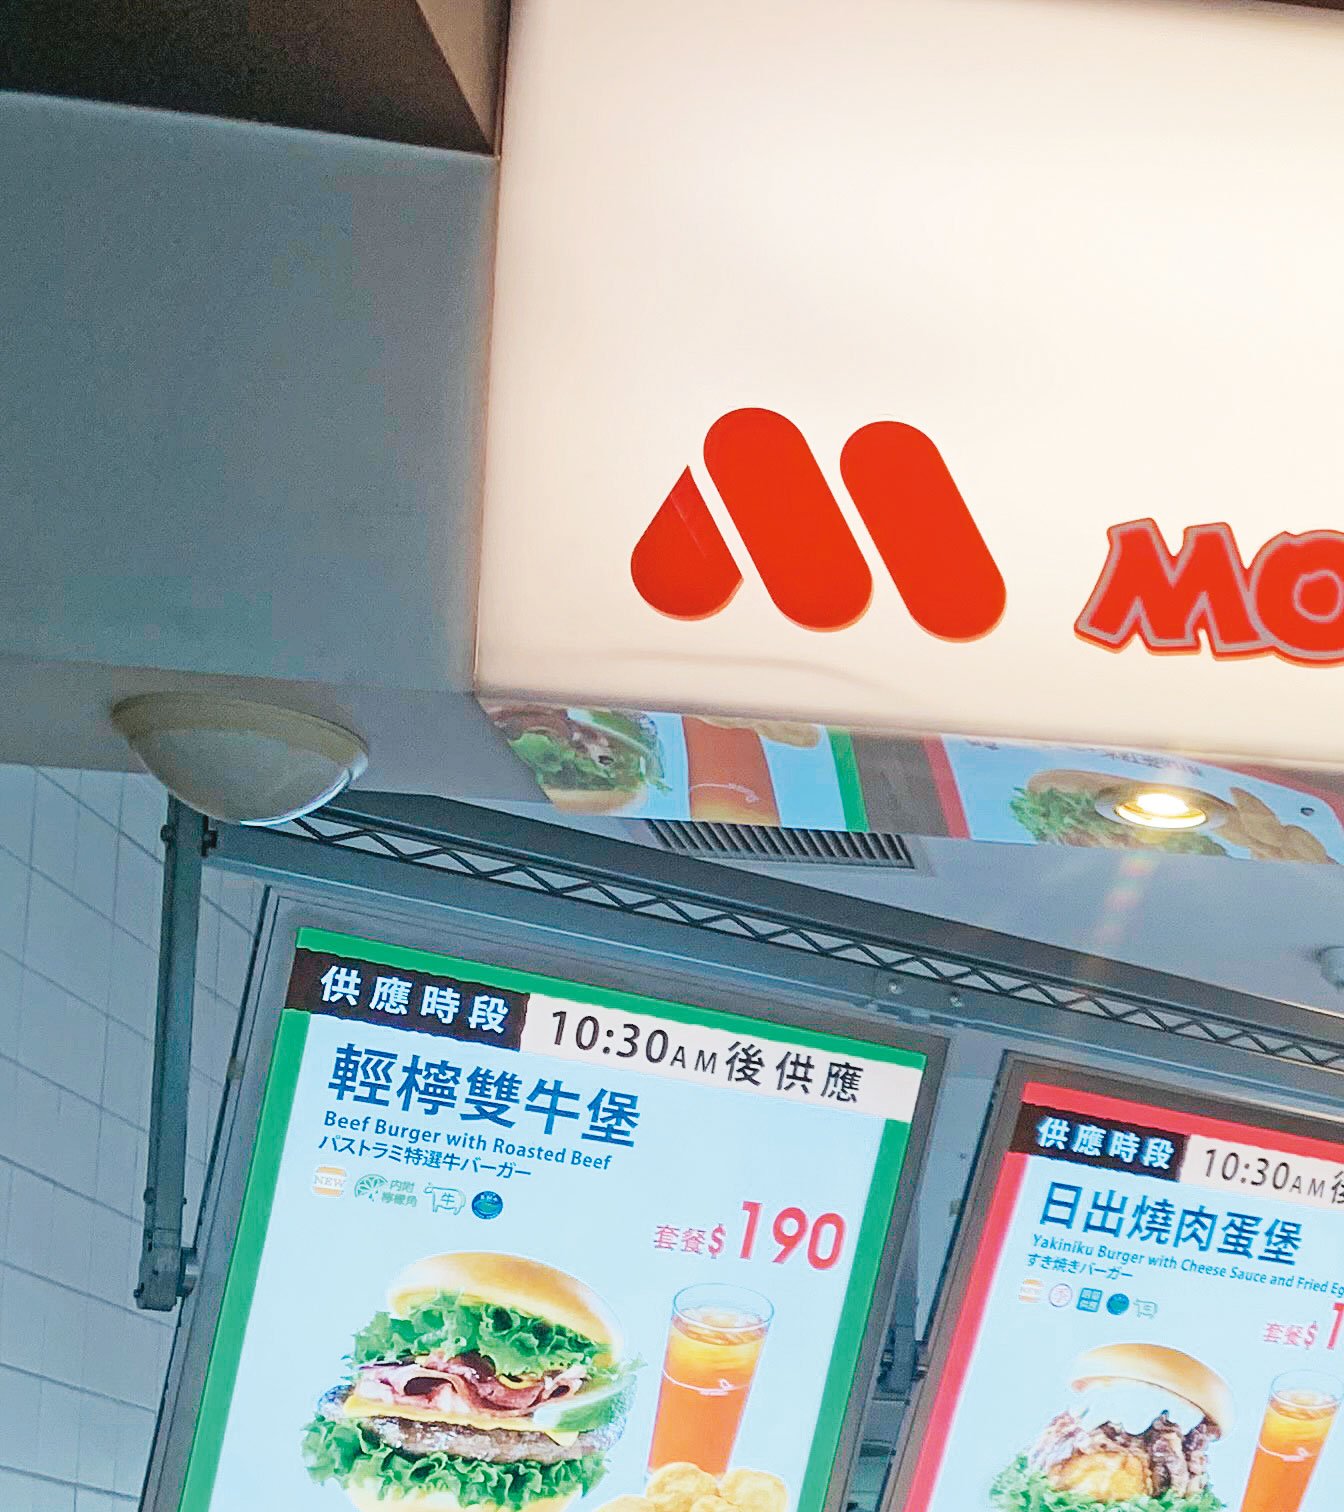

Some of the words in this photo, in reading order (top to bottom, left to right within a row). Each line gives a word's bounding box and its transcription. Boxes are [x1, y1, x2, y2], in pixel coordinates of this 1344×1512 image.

[321, 966, 510, 1035] 供應時段
[551, 1010, 864, 1104] 10:30AM後供應
[328, 1042, 641, 1149] 輕檸雙牛堡
[318, 1134, 532, 1180] パストラミ特選牛バーガー
[324, 1110, 371, 1133] Beef
[375, 1118, 441, 1145] Burger
[447, 1131, 487, 1152] with
[493, 1138, 565, 1163] Roasted
[571, 1150, 612, 1171] Beef
[1036, 1115, 1177, 1170] 供應時段
[654, 1200, 848, 1271] 套餐$190
[1039, 1182, 1304, 1267] 日出燒肉蛋堡
[1027, 1252, 1134, 1282] すき焼きバーガー
[1032, 1234, 1095, 1258] Yakiniku
[1098, 1245, 1144, 1266] Burger
[1148, 1254, 1178, 1270] with
[1181, 1258, 1227, 1279] Cheese
[1229, 1266, 1267, 1285] Sauce
[1269, 1273, 1294, 1289] and
[1297, 1277, 1328, 1294] Fried
